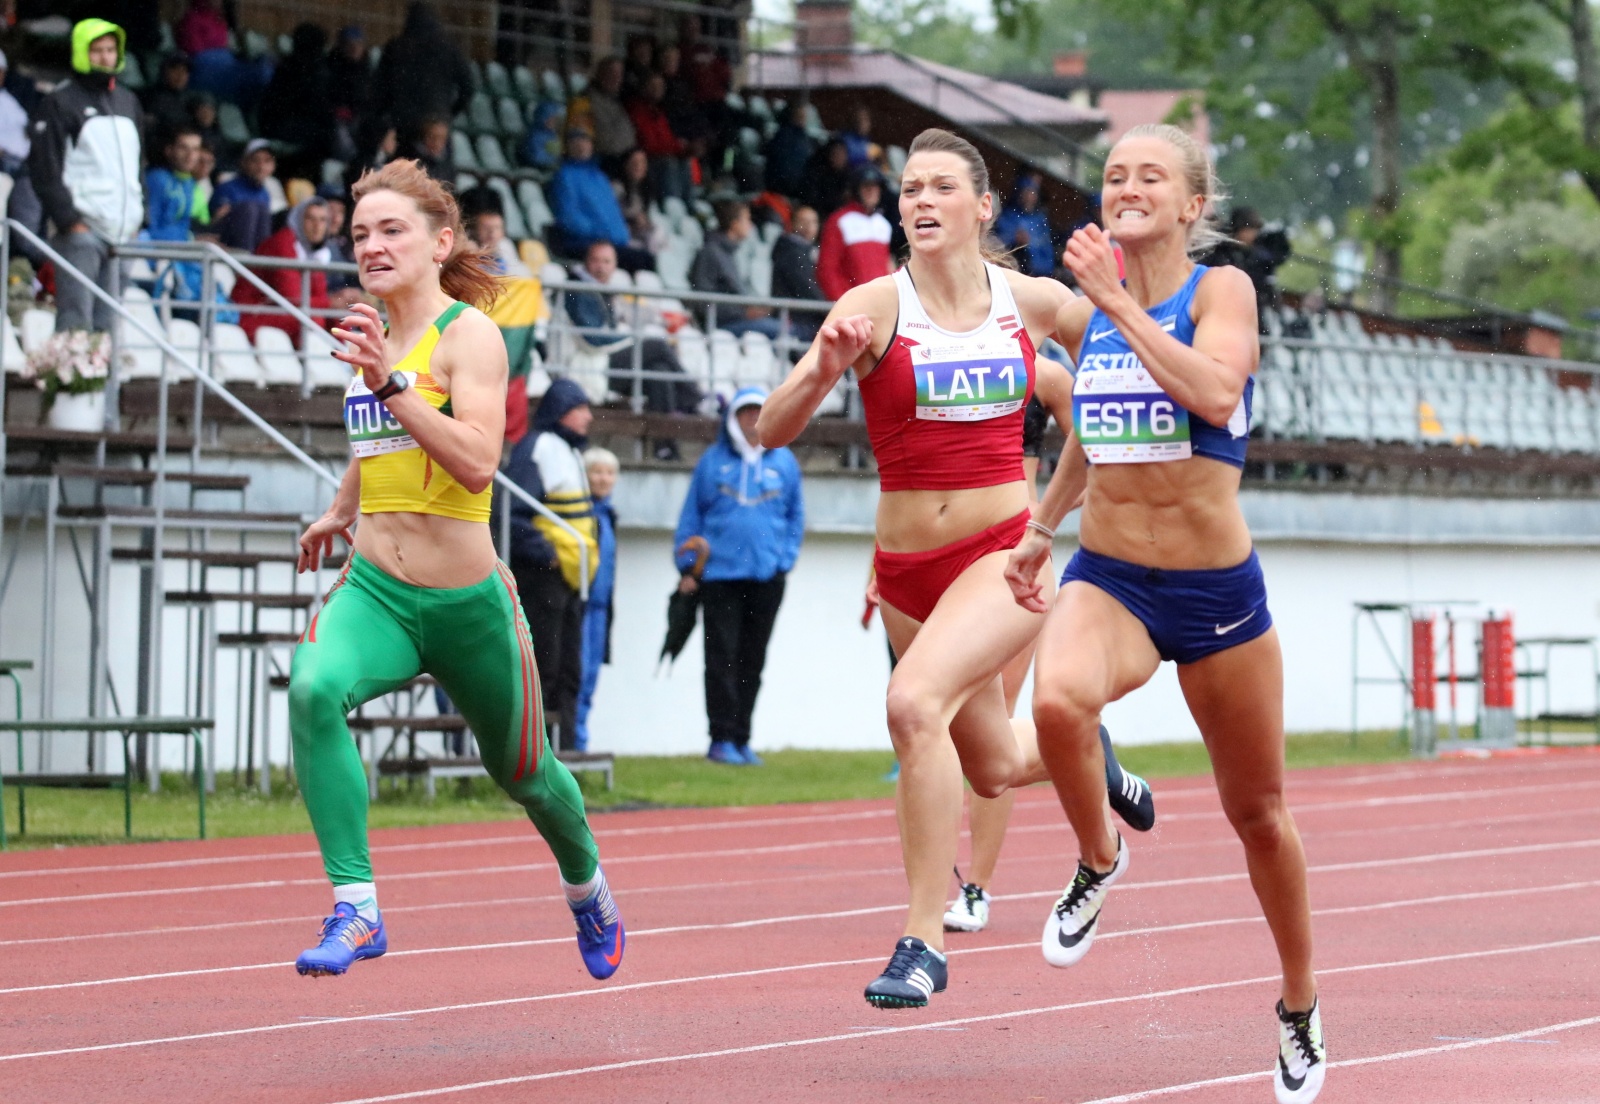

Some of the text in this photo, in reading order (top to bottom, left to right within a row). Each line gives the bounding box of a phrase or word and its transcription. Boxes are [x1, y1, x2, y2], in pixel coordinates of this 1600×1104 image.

[927, 365, 1015, 401] LAT 1
[348, 402, 382, 435] LTU
[1081, 401, 1176, 438] EST 6
